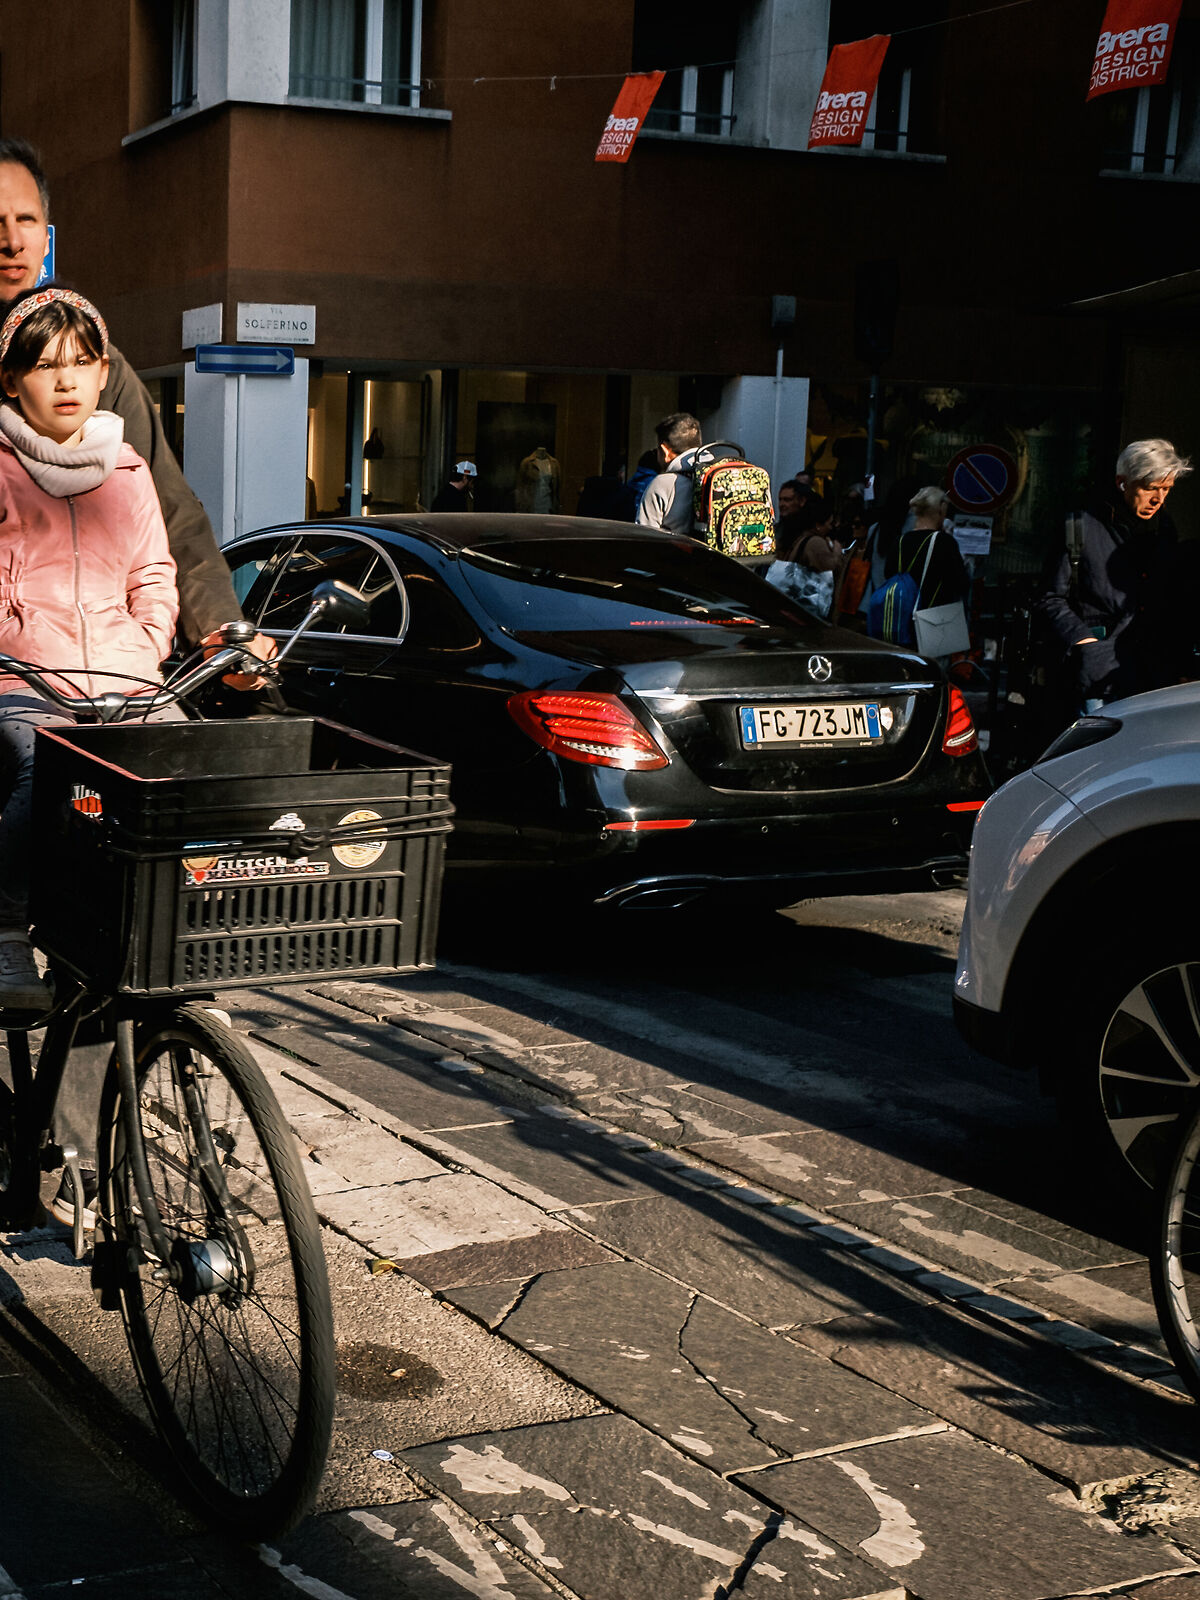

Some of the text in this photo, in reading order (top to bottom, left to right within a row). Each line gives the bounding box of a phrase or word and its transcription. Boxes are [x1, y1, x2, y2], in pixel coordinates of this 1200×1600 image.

[1095, 22, 1169, 58] Brera
[1091, 44, 1167, 75] DESIGN
[601, 132, 634, 145] ESIGN
[244, 319, 308, 331] SOLFERINO
[759, 709, 788, 738] FG
